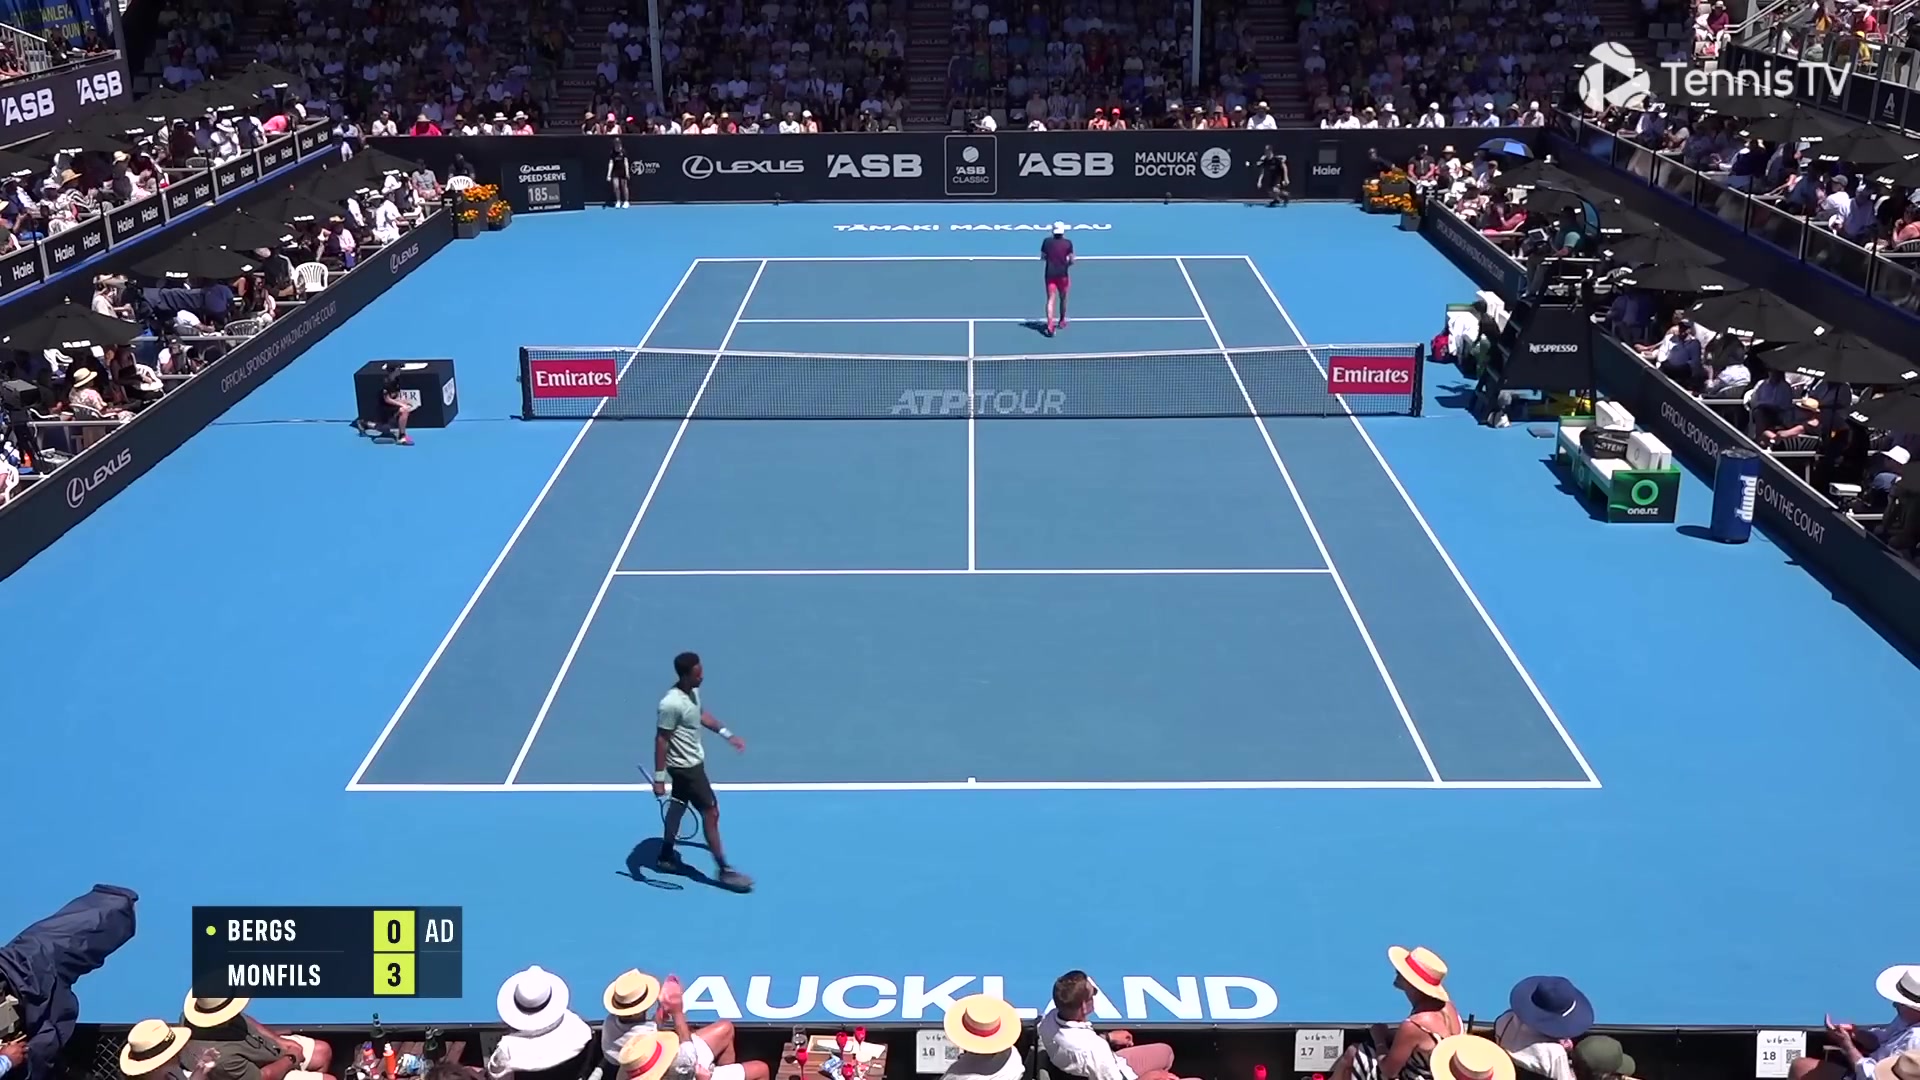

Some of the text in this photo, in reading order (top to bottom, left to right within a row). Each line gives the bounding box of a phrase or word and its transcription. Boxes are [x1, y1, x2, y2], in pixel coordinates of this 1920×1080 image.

[76, 70, 123, 106] ASB
[1, 88, 55, 127] ASB
[264, 153, 277, 167] Haier
[281, 146, 294, 159] Haier
[1135, 152, 1196, 163] MANUKA
[240, 164, 254, 179] Haier
[716, 160, 805, 174] LEXUS
[827, 154, 923, 178] ASB
[955, 166, 986, 175] ASB
[1018, 152, 1114, 176] ASB
[1135, 164, 1196, 176] DOCTOR
[1312, 165, 1341, 176] Haier
[221, 172, 236, 187] Haier
[519, 172, 566, 183] SPEED SERVE
[952, 176, 989, 184] CLASSIC
[194, 183, 210, 199] Haier
[528, 187, 548, 202] 185
[172, 193, 189, 209] Haier
[141, 206, 159, 223] Haier
[117, 216, 135, 234] Haier
[950, 222, 1112, 231] MAKAUAU
[82, 231, 101, 250] Haier
[54, 244, 76, 263] Haier
[12, 260, 35, 281] Haier
[1528, 342, 1579, 354] NESPRESSO
[221, 365, 248, 393] OFFICIAL
[246, 348, 273, 376] SPONSOR
[279, 324, 304, 350] AMAZING
[535, 369, 612, 387] Emirates
[1332, 366, 1409, 383] Emirates
[890, 388, 1067, 414] ATP TOUR
[1661, 401, 1719, 460] OFFICIAL SPONSOR
[84, 447, 132, 491] LEXUS
[1735, 474, 1758, 523] pump
[1627, 507, 1659, 515] one.nz
[1764, 484, 1779, 508] ON
[1778, 494, 1795, 521] THE
[1794, 508, 1825, 544] COURT
[1300, 1047, 1315, 1057] 17
[1762, 1051, 1777, 1061] 18
